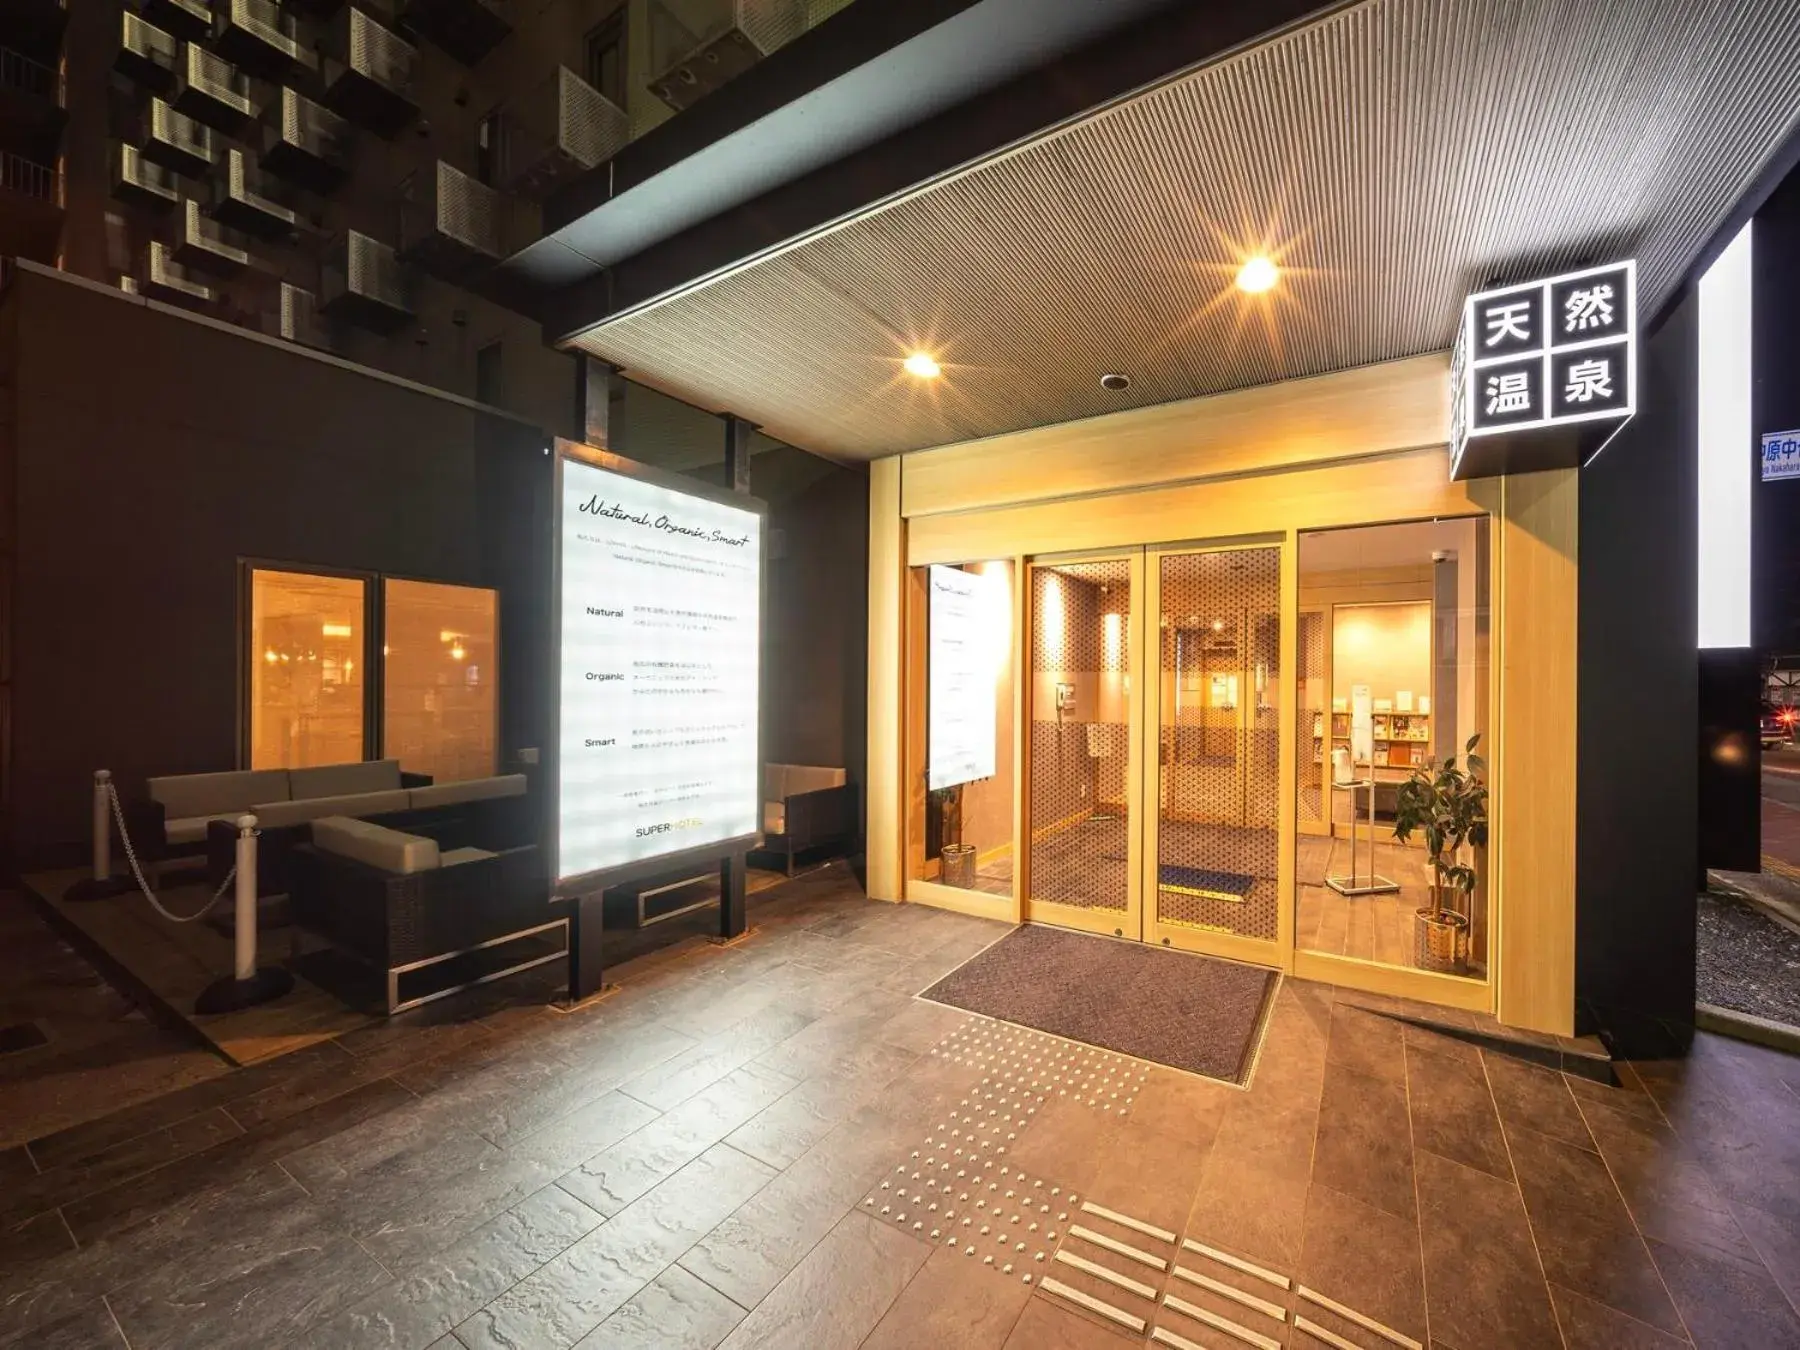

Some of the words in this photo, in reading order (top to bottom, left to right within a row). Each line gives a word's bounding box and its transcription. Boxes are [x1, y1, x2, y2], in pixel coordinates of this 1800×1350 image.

[712, 530, 749, 547] Smart
[586, 606, 624, 618] Natural
[585, 672, 625, 681] Organic
[584, 738, 616, 747] Smart
